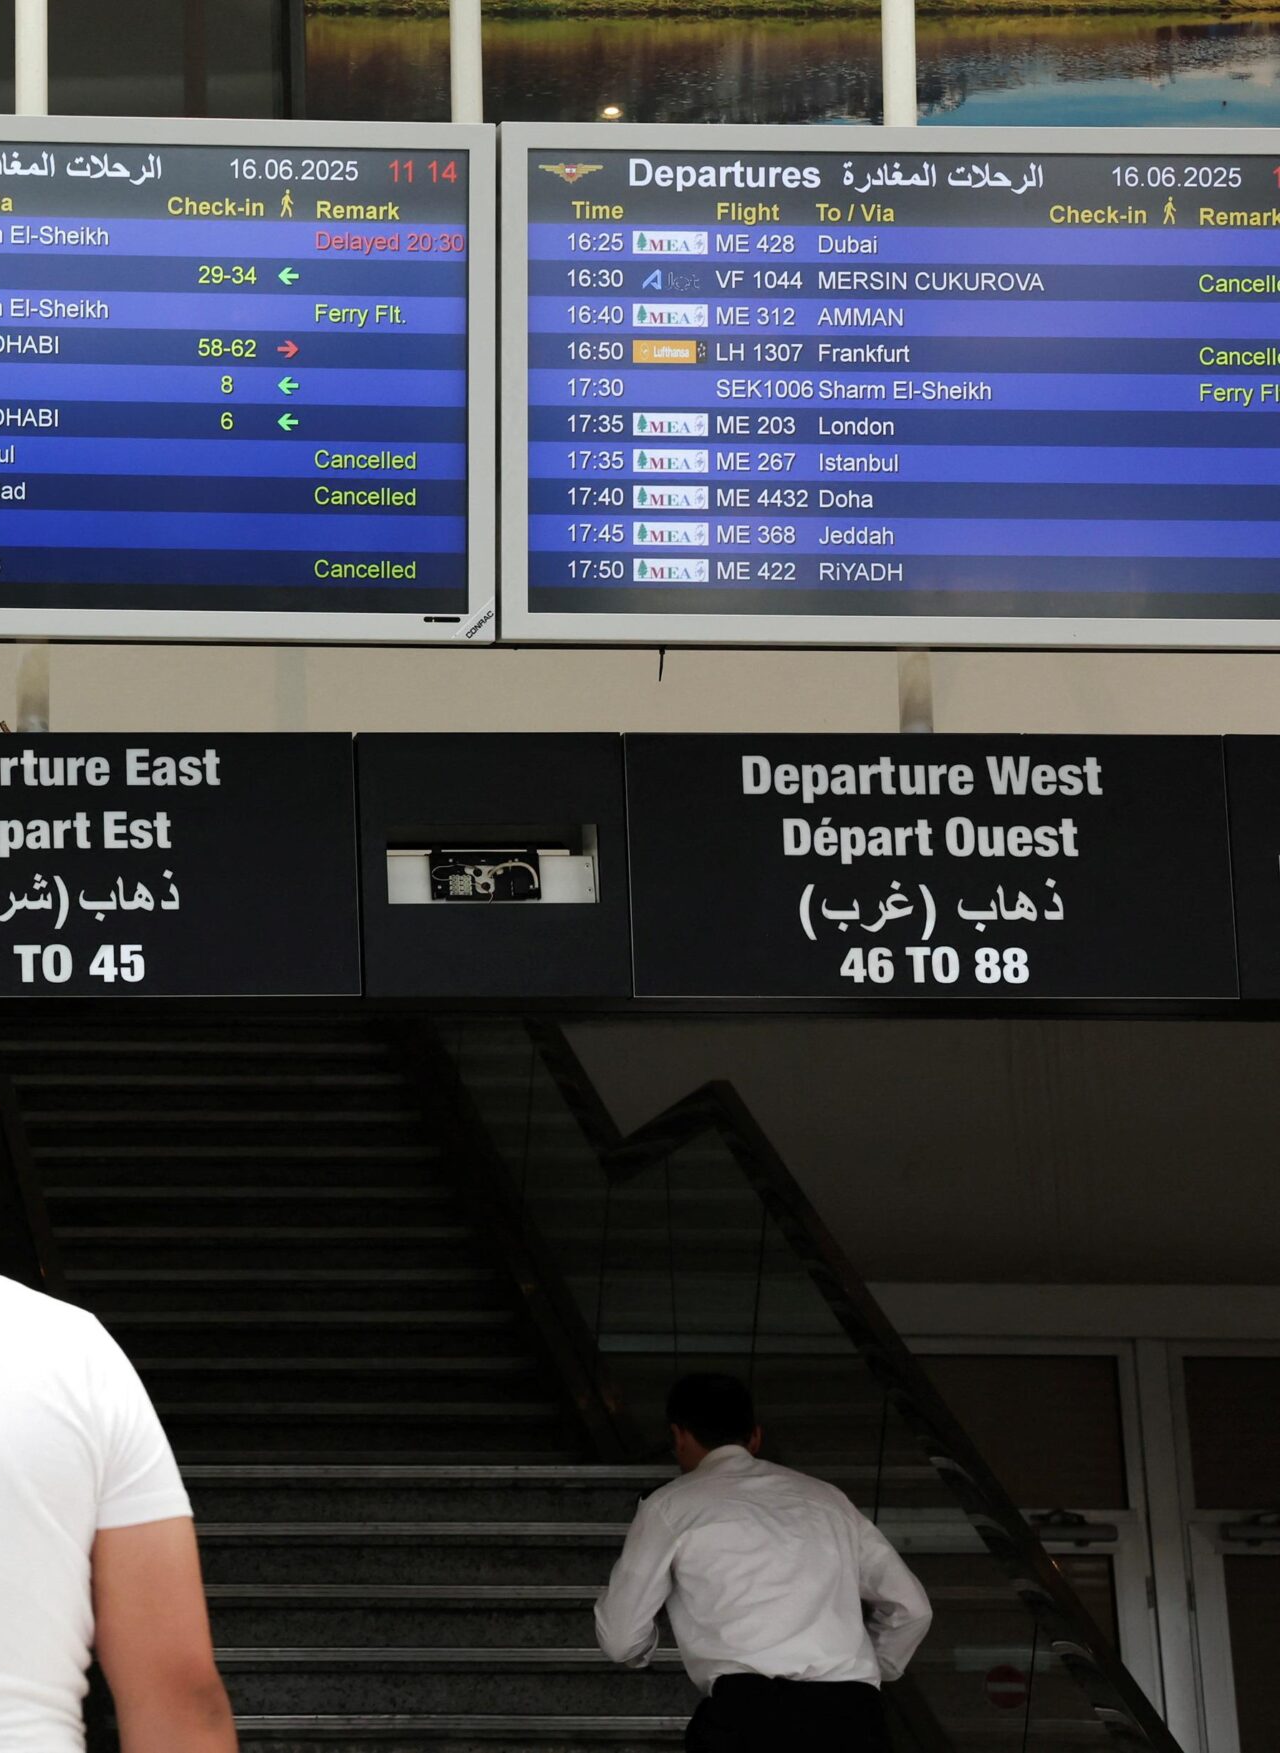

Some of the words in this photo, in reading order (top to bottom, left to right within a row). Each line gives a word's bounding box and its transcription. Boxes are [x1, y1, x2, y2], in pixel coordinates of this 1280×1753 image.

[66, 153, 162, 186] الرحلات
[230, 158, 359, 181] 16.06.2025
[389, 159, 413, 183] 11
[428, 160, 457, 183] 14
[629, 158, 821, 192] Departures
[843, 161, 937, 194] المغادرة
[947, 162, 1044, 195] الرحلات
[1112, 166, 1242, 188] 16.06.2025
[167, 196, 264, 217] Check-in
[316, 200, 400, 220] Remark
[571, 200, 624, 220] Time
[717, 202, 780, 226] Flight
[815, 203, 842, 222] To
[847, 203, 855, 222] /
[860, 203, 895, 222] Via
[1049, 205, 1147, 224] Check-in
[1199, 207, 1280, 226] Remark
[10, 225, 109, 246] El-Sheikh
[315, 231, 401, 256] Delayed
[407, 233, 465, 253] 20:30
[198, 265, 257, 285] 29-34
[567, 268, 624, 288] 16:30
[715, 270, 745, 289] VF
[753, 270, 803, 289] 1044
[818, 271, 907, 291] MERSIN
[914, 271, 1045, 292] CUKUROVA
[1198, 273, 1280, 293] Cancell
[10, 298, 109, 319] El-Sheikh
[315, 303, 369, 328] Ferry
[375, 304, 406, 324] Flt.
[567, 341, 624, 360] 16:50
[716, 342, 745, 362] LH
[753, 343, 803, 362] 1307
[818, 343, 910, 363] Frankfurt
[1199, 346, 1280, 366] Cancell
[567, 377, 624, 397] 17:30
[716, 378, 814, 398] SEK1006
[818, 379, 886, 399] Sharm
[893, 380, 992, 400] El-Sheikh
[1199, 383, 1254, 407] Ferry
[1261, 383, 1280, 402] Fl
[567, 414, 624, 433] 17:35
[650, 420, 691, 434] MEA
[716, 415, 750, 434] ME
[757, 416, 796, 435] 203
[818, 416, 895, 436] London
[314, 449, 416, 470] Cancelled
[465, 610, 494, 639] CONRAC
[125, 748, 221, 787] East
[741, 755, 974, 804] Departure
[985, 755, 1103, 796] West
[103, 810, 172, 850] Est
[782, 817, 934, 865] Départ
[945, 816, 1079, 858] Ouest
[78, 869, 180, 922] ذهاب
[799, 880, 937, 941] (غرب)
[957, 877, 1064, 933] ذهاب
[13, 943, 73, 983] TO
[89, 944, 145, 983] 45
[839, 947, 895, 984] 46
[905, 946, 960, 984] TO
[974, 947, 1030, 984] 88
